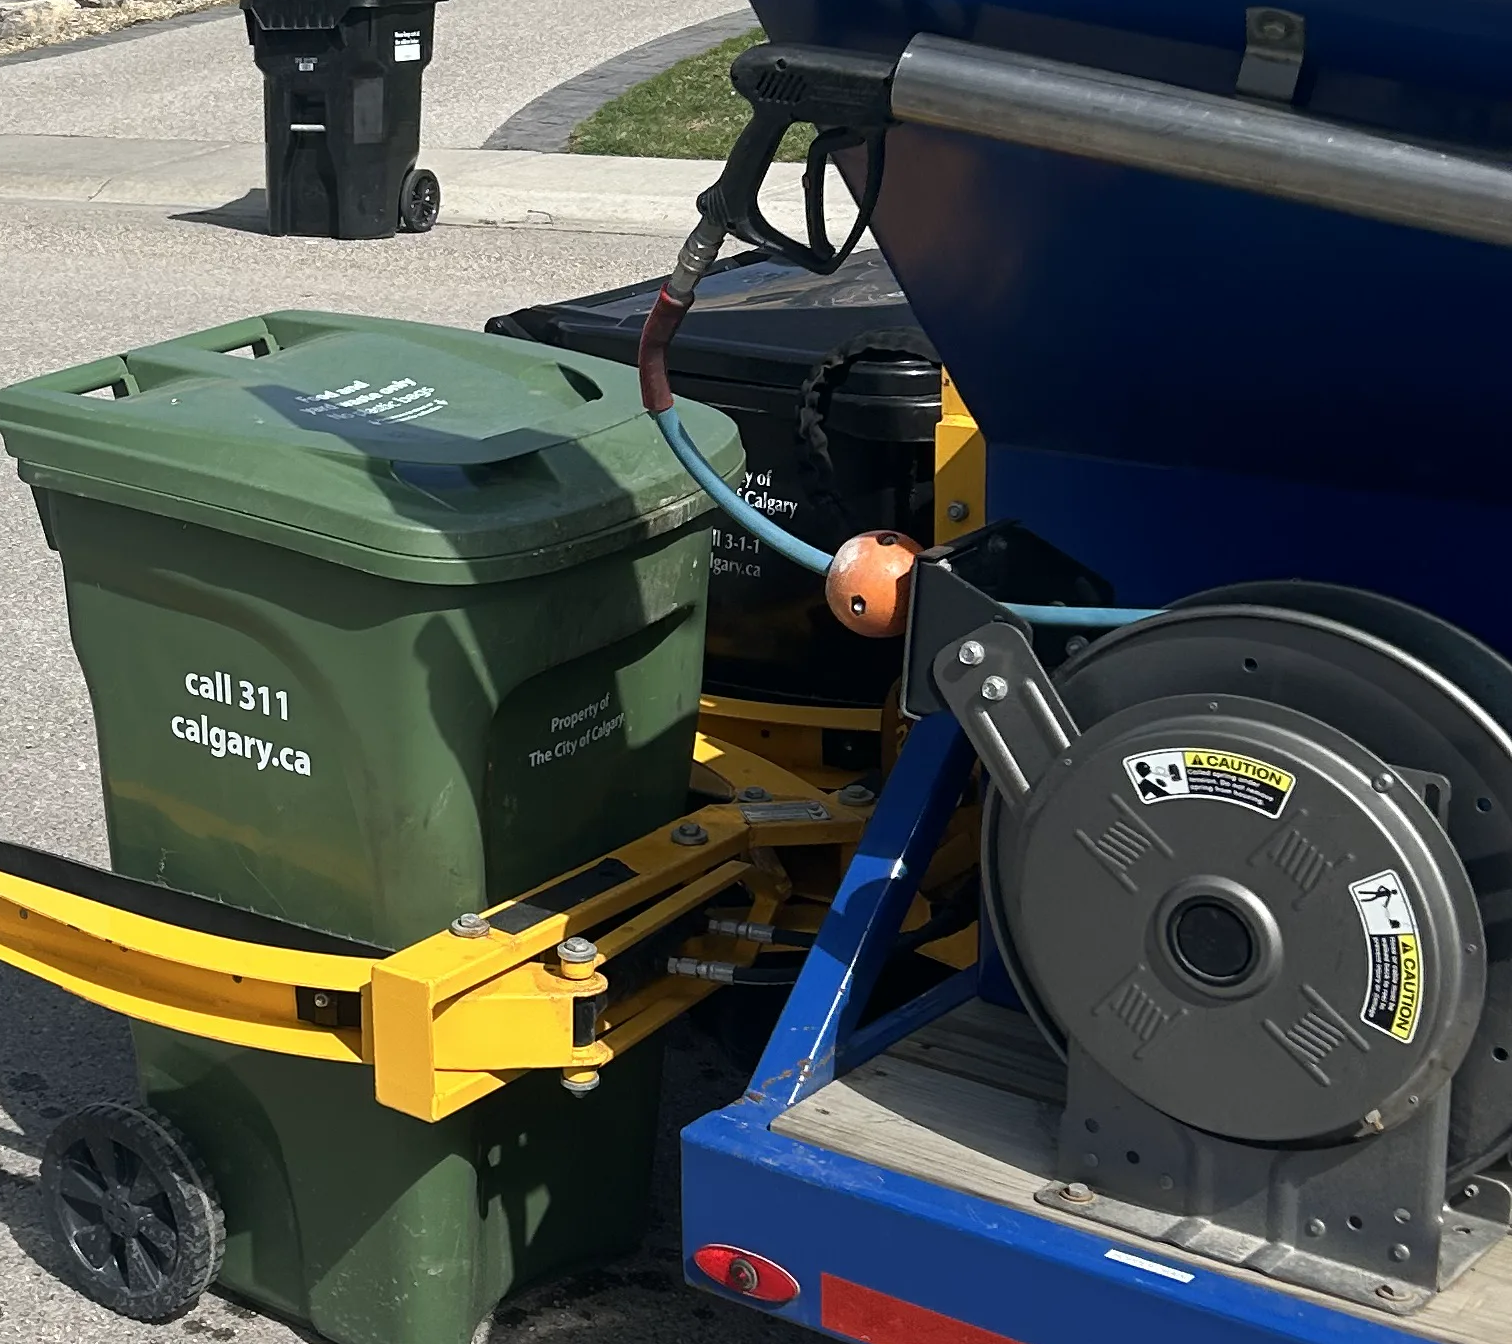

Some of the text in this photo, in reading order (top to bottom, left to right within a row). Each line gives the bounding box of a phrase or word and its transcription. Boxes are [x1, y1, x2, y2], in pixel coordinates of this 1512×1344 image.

[756, 469, 772, 487] of
[744, 490, 798, 520] Calgary
[724, 533, 760, 554] 3-1-1
[710, 552, 761, 578] lgary.ca
[185, 670, 288, 721] call 311
[551, 692, 610, 733] Property of
[170, 714, 312, 776] calgary.ca
[528, 713, 625, 767] The City of Calgary
[1206, 756, 1282, 786] CAUTION
[1396, 958, 1416, 1031] CAUTION
